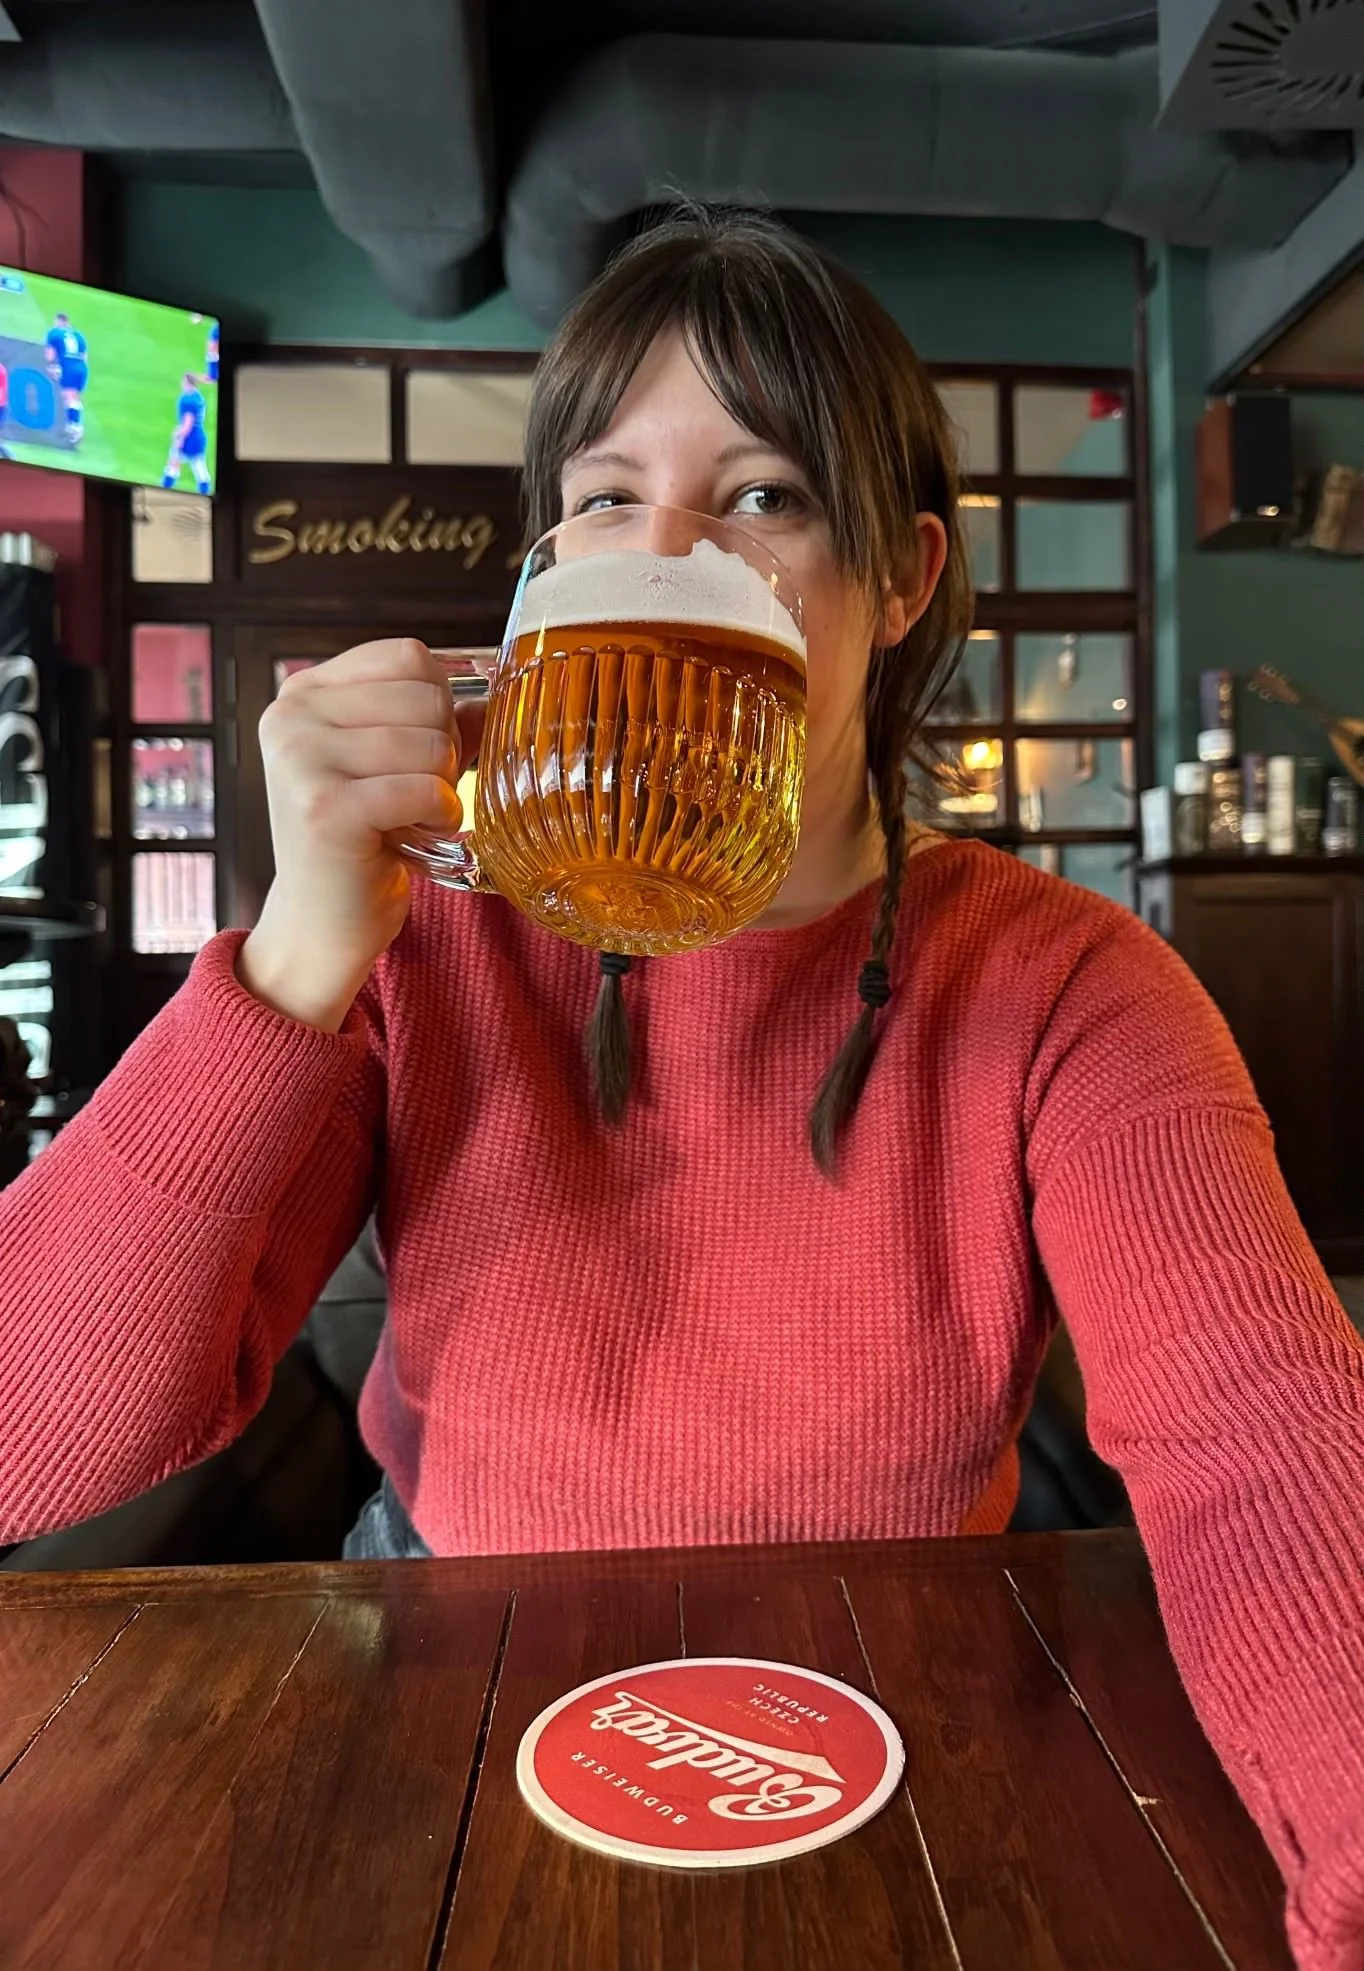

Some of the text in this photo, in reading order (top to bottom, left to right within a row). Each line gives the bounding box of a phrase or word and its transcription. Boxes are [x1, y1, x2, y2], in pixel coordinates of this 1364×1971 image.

[249, 495, 494, 570] Smoking
[748, 1697, 800, 1724] CZECH
[752, 1683, 829, 1723] REPUBLIC
[570, 1751, 688, 1824] BUDWEISER
[590, 1691, 843, 1821] Budvar
